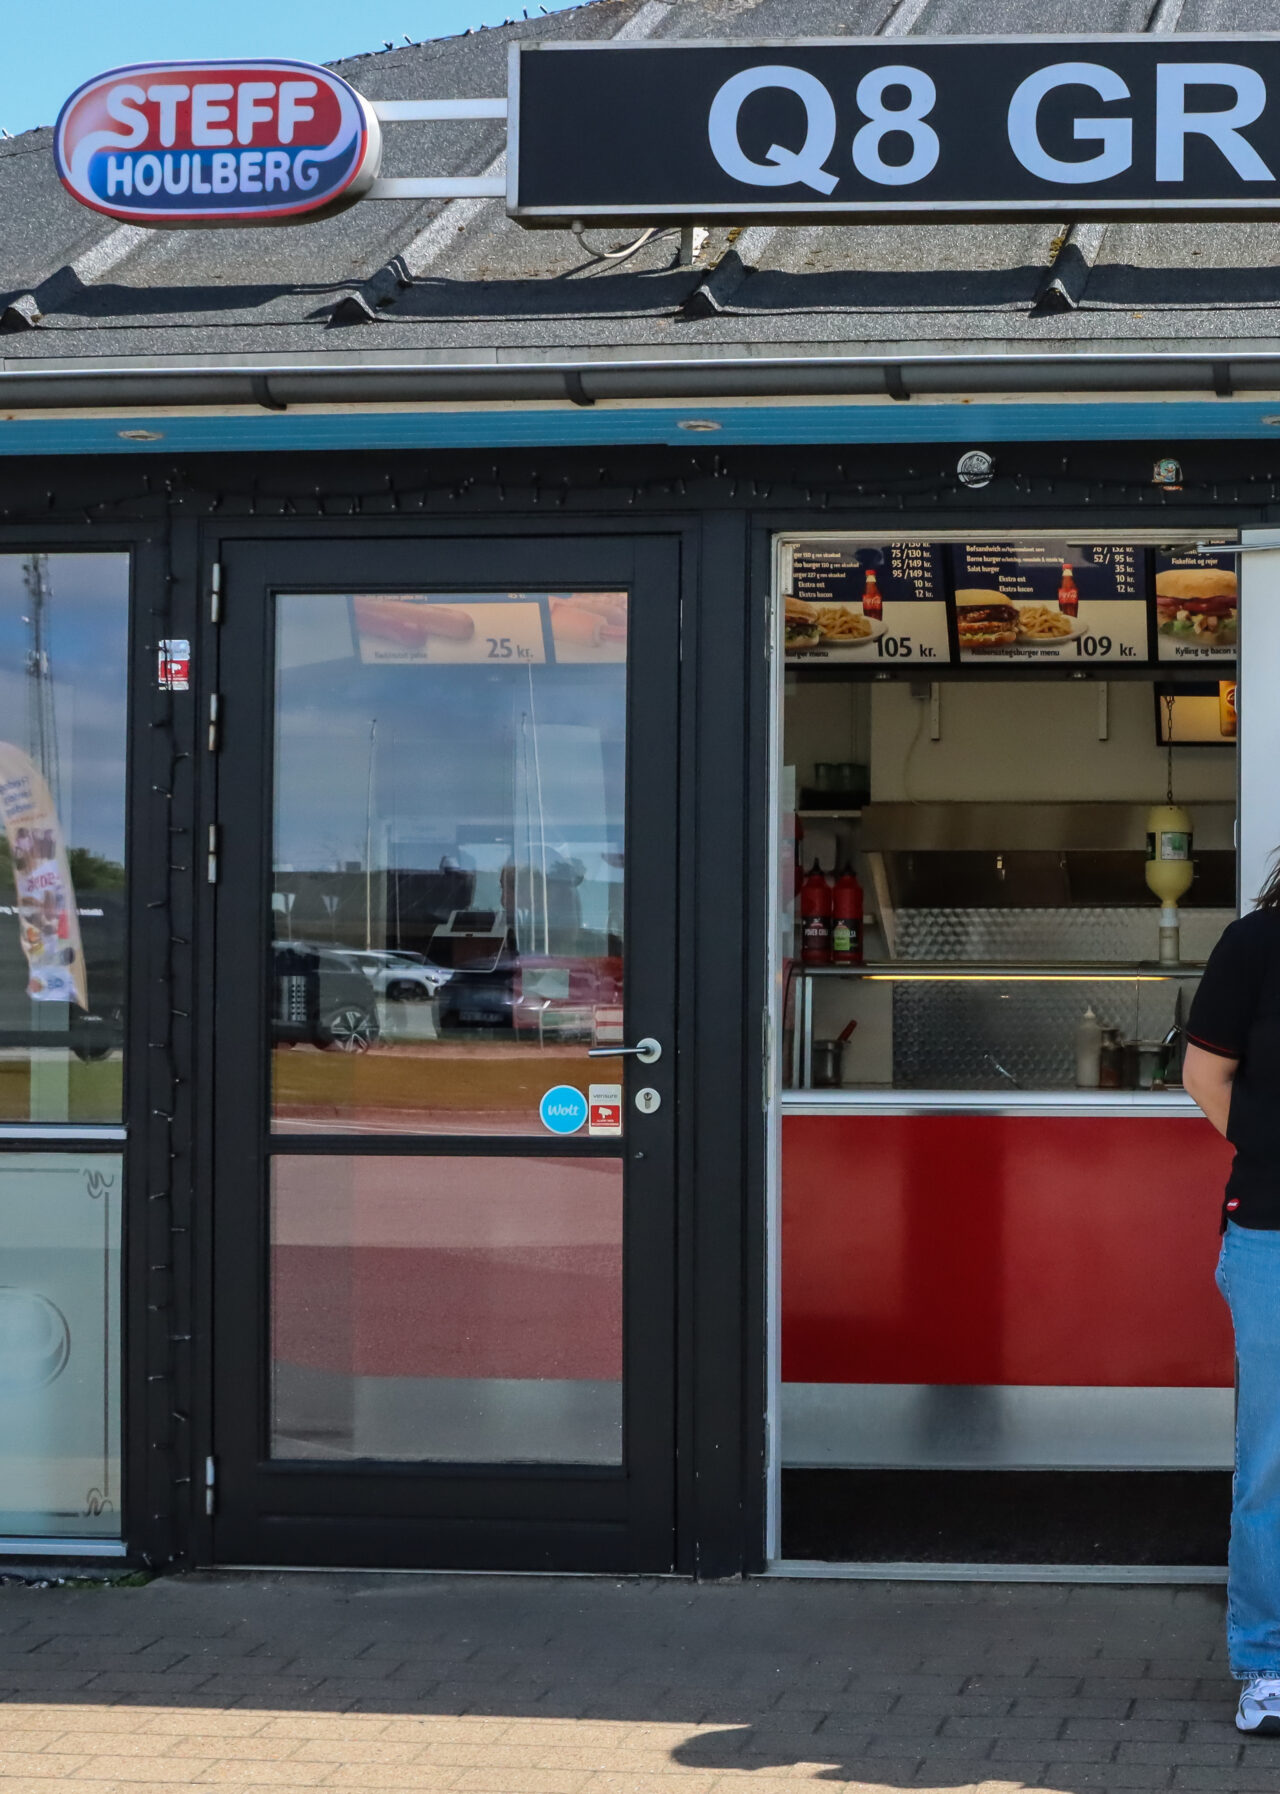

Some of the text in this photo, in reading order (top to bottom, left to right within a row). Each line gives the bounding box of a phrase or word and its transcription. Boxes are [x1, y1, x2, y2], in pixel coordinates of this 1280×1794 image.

[106, 81, 319, 149] STEFF
[708, 64, 940, 196] Q8
[106, 150, 320, 196] HOULBERG
[1094, 554, 1103, 562] 52
[1114, 554, 1124, 562] 95
[486, 638, 534, 659] 25 kr.
[873, 636, 936, 658] 105 kr.
[1072, 636, 1137, 657] 109 kr.
[1175, 647, 1199, 656] Kylling
[1201, 648, 1209, 656] og
[547, 1104, 580, 1117] Wolt
